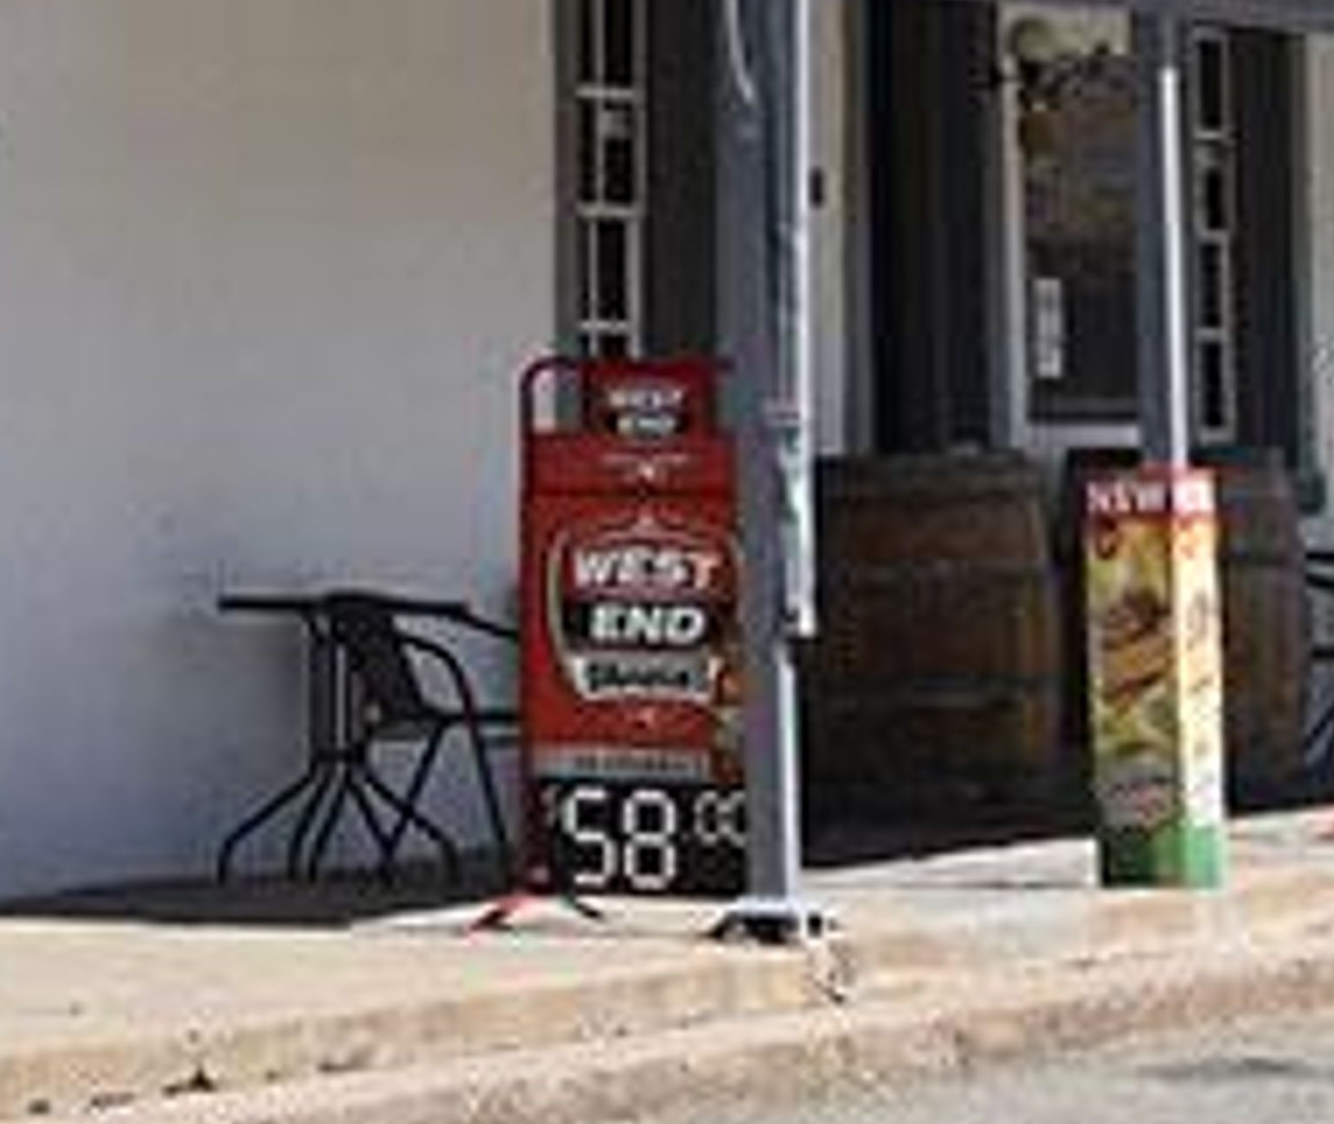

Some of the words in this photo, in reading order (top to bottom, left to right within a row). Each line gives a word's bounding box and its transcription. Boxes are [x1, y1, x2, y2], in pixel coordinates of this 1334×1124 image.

[574, 545, 721, 590] WEST
[590, 604, 706, 645] END
[560, 785, 678, 891] 58
